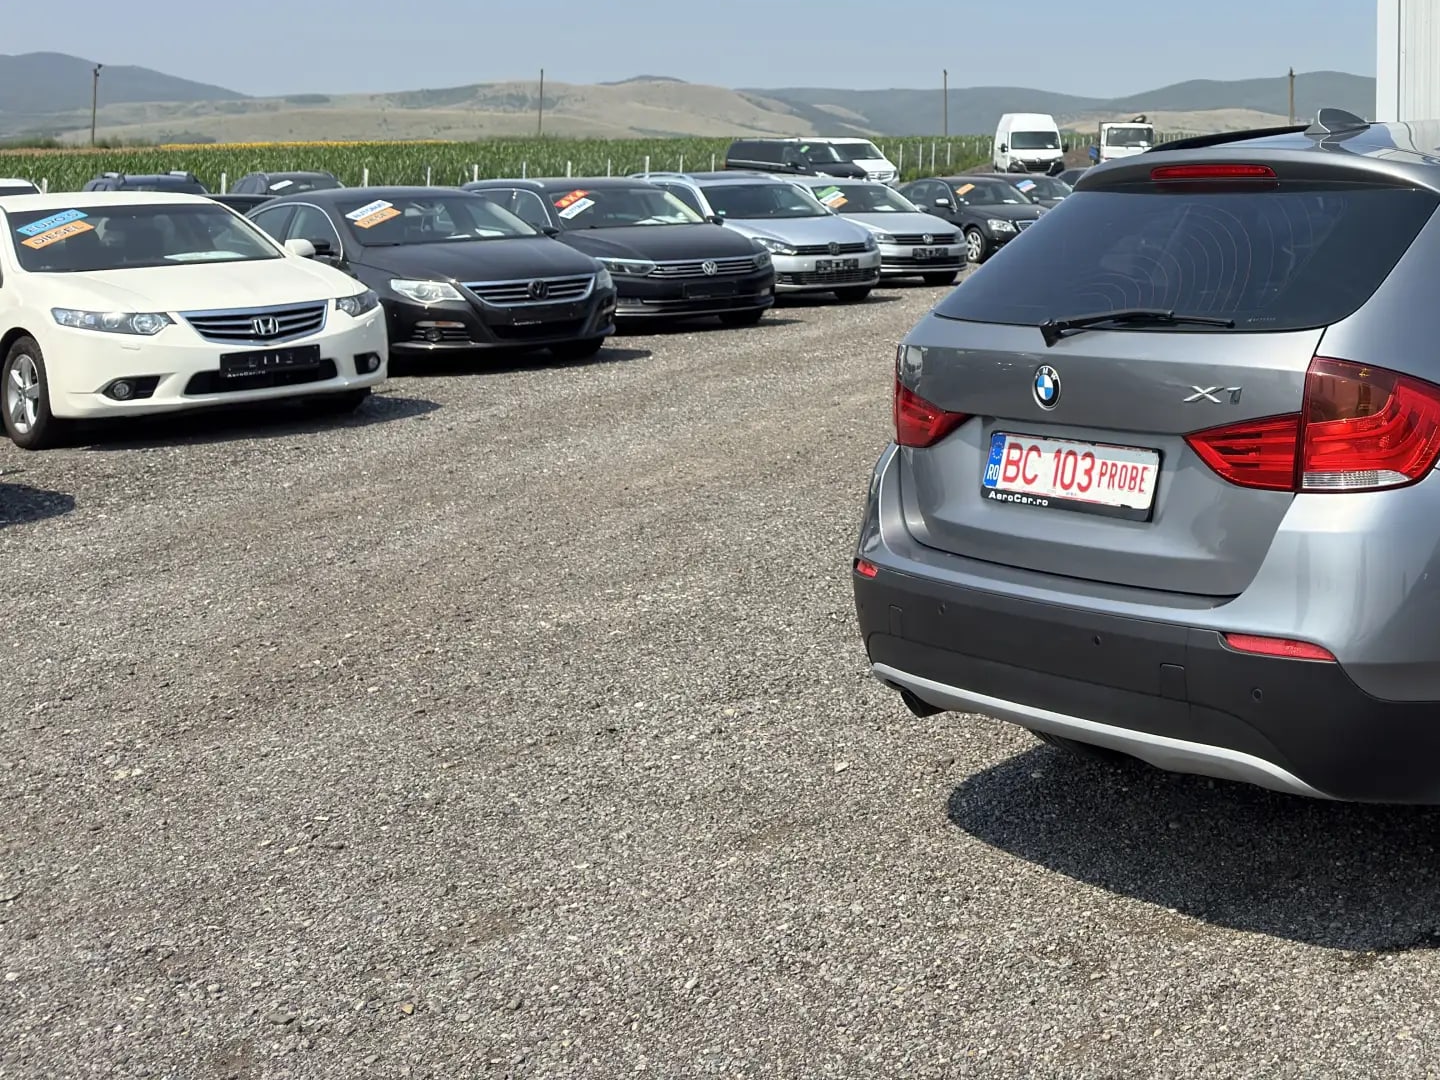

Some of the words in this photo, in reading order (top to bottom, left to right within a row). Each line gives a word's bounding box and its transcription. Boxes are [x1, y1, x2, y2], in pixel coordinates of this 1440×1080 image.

[32, 223, 86, 246] DIESEL
[1183, 385, 1243, 406] X1
[986, 463, 1000, 481] RO
[1002, 441, 1043, 486] BC
[1052, 447, 1096, 493] 103
[1097, 461, 1150, 494] PROBE
[987, 490, 1049, 508] AeroCar.ro
